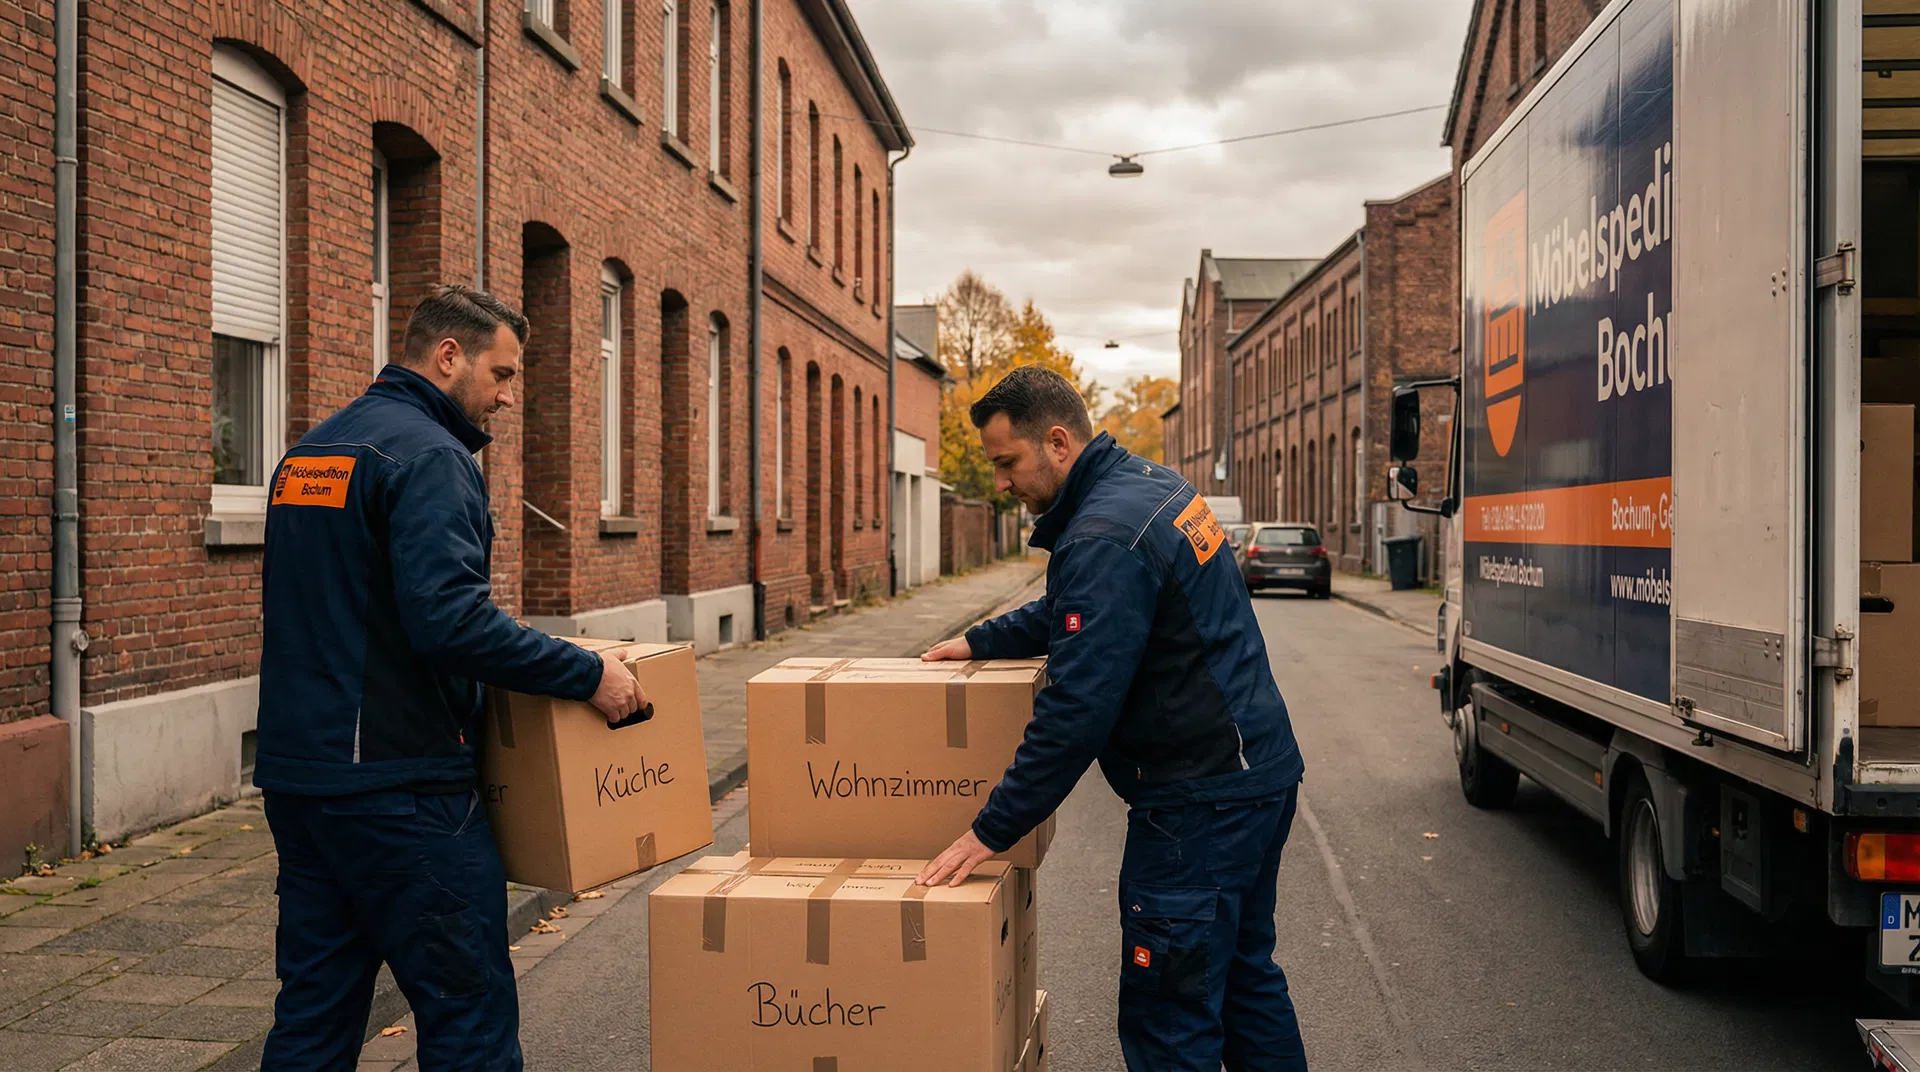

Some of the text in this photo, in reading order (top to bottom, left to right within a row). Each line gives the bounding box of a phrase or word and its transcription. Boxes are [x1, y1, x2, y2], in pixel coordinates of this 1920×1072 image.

[594, 756, 675, 807] Küche
[807, 760, 988, 799] Wohnzimmer
[1888, 916, 1894, 924] D
[747, 981, 886, 1028] Bücher
